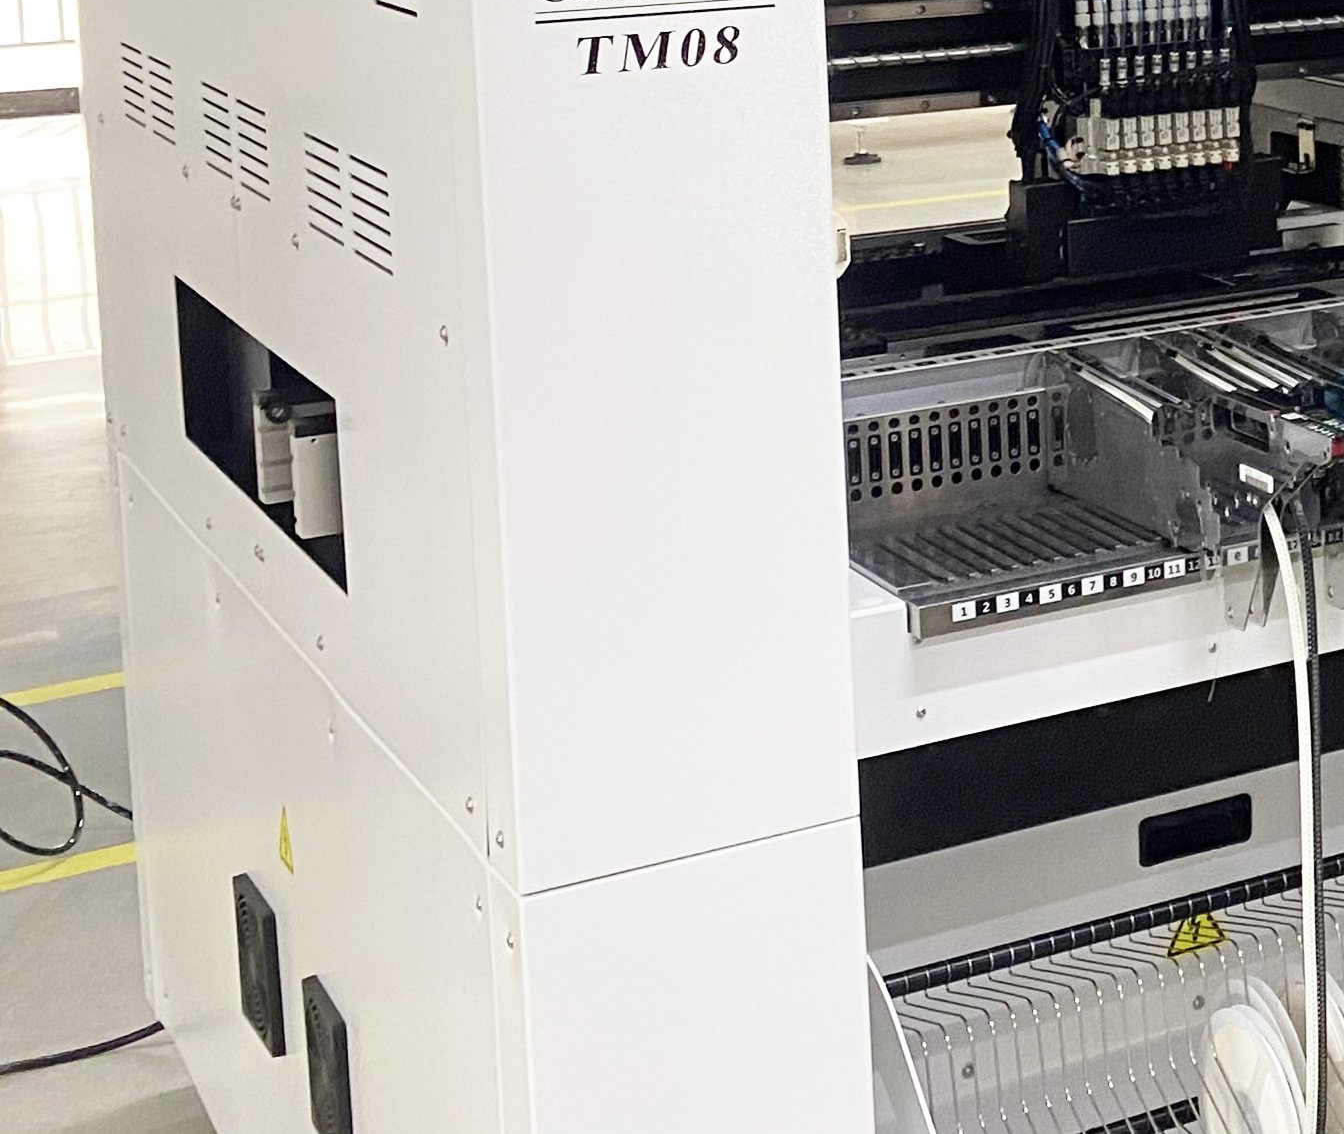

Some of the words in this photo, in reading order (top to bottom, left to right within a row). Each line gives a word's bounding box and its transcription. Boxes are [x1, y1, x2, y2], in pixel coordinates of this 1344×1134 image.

[577, 25, 740, 76] TM08
[982, 602, 990, 613] 2
[1004, 598, 1011, 607] 3
[1025, 593, 1033, 604] 4
[1048, 589, 1055, 599] 5
[1067, 584, 1076, 595] 6
[1089, 580, 1096, 591] 7
[1109, 576, 1117, 587] 8
[1130, 572, 1137, 582] 9
[1147, 567, 1162, 579] 10
[1168, 565, 1181, 575] 11
